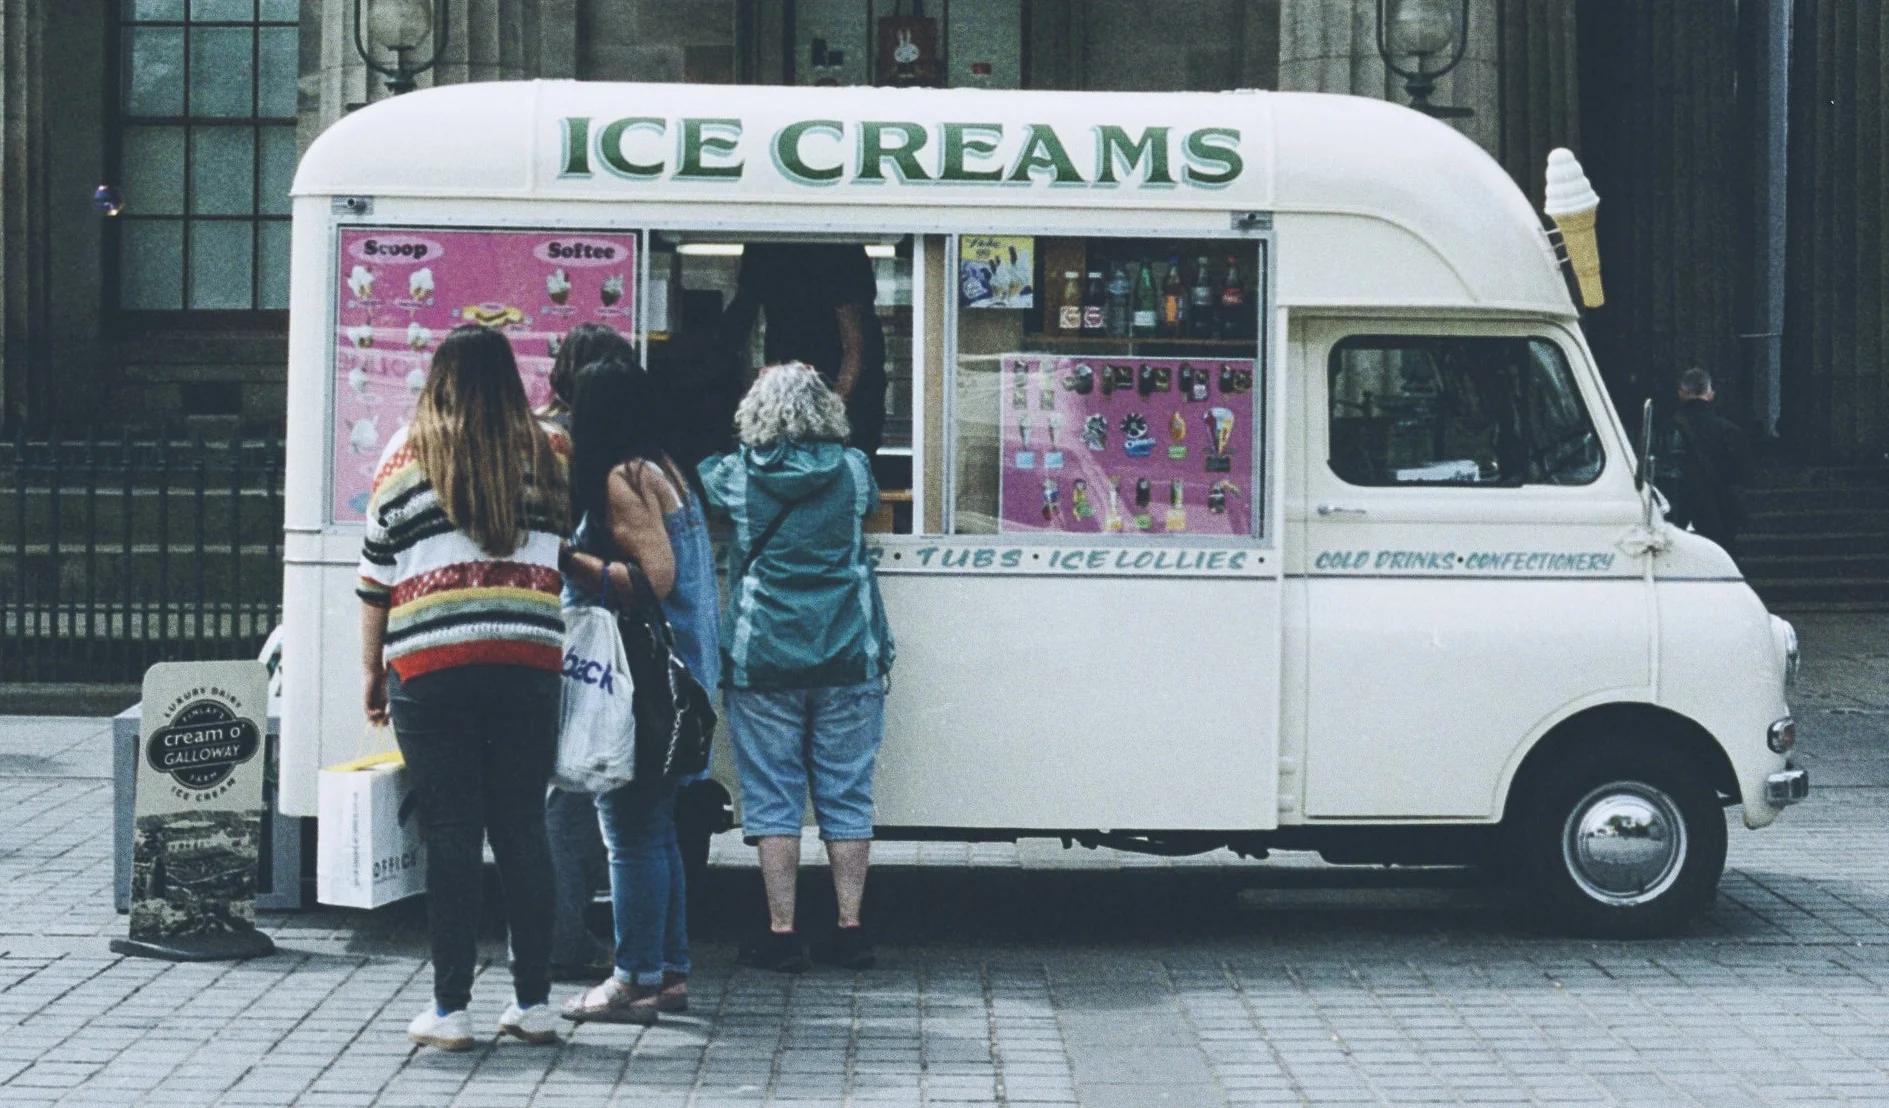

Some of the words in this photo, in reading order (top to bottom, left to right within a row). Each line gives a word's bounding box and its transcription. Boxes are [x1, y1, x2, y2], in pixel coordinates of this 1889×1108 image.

[557, 117, 745, 183] ICE
[769, 119, 1244, 190] CREAMS
[364, 239, 428, 259] Scoop
[547, 242, 616, 259] Softee
[916, 547, 1022, 567] TUBS
[1049, 550, 1110, 570] ICE
[1115, 550, 1247, 570] LOLLIES
[1315, 550, 1369, 570] COLD
[1374, 550, 1456, 570] DRINKS
[1465, 551, 1615, 571] CONFECTIONERY
[164, 728, 223, 747] cream
[164, 745, 240, 766] GALLOWAY
[195, 778, 236, 802] CREAM
